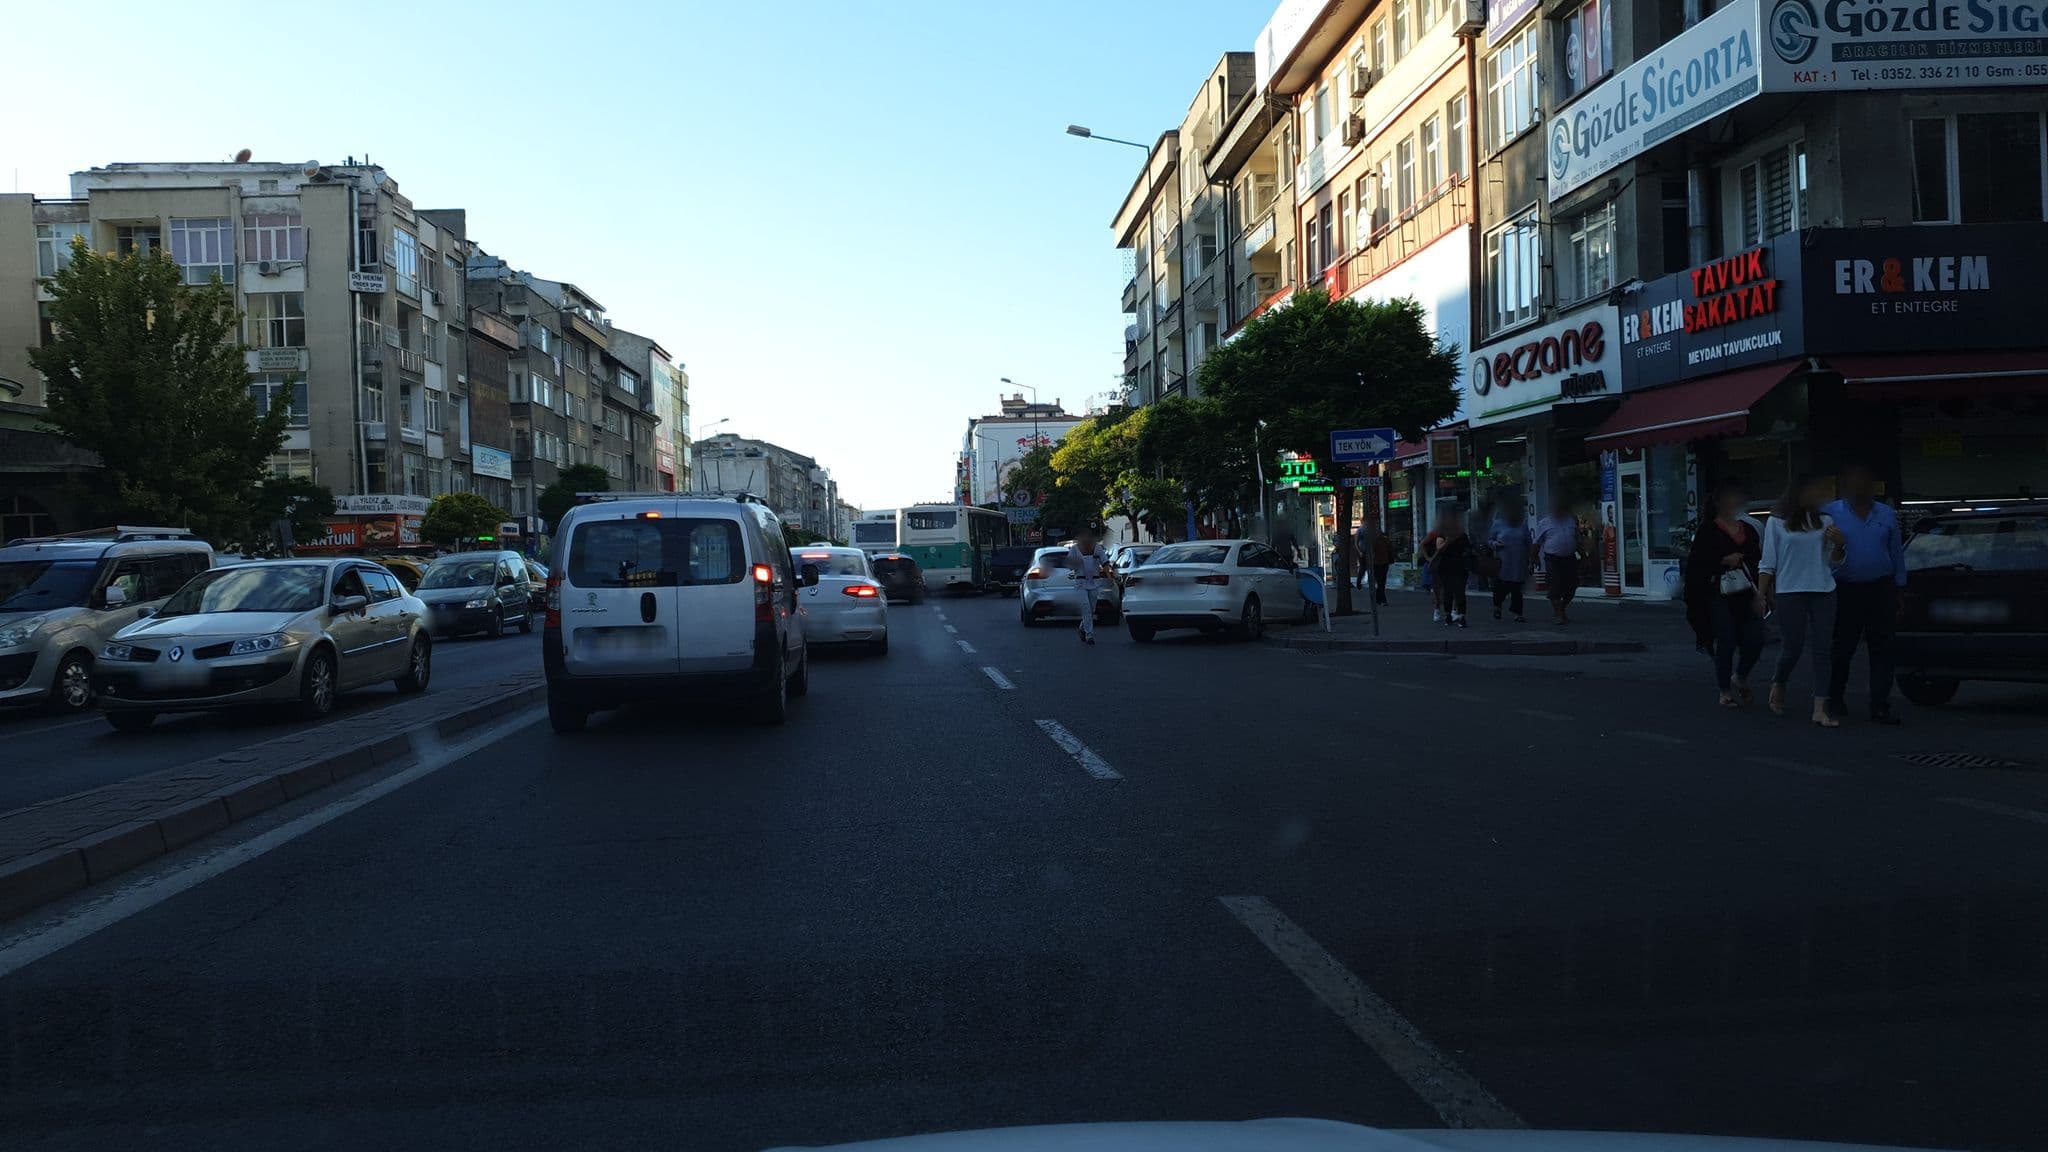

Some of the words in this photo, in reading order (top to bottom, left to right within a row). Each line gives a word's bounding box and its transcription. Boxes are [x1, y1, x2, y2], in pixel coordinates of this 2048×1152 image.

[1793, 71, 1819, 83] KAT
[1851, 69, 1871, 81] Tel
[1920, 67, 1942, 79] 336
[1946, 66, 1960, 78] 21
[1966, 66, 1980, 77] 10
[1986, 65, 2014, 77] Gsm
[1690, 247, 1765, 298] TAVUK
[1683, 279, 1777, 334] SAKATAT
[1871, 302, 1888, 314] ET
[1895, 300, 1960, 314] ENTEGRE
[1493, 321, 1605, 387] eczane
[1688, 345, 1723, 365] MEYDAN
[1338, 441, 1353, 451] TEK
[1355, 439, 1372, 451] YÖN
